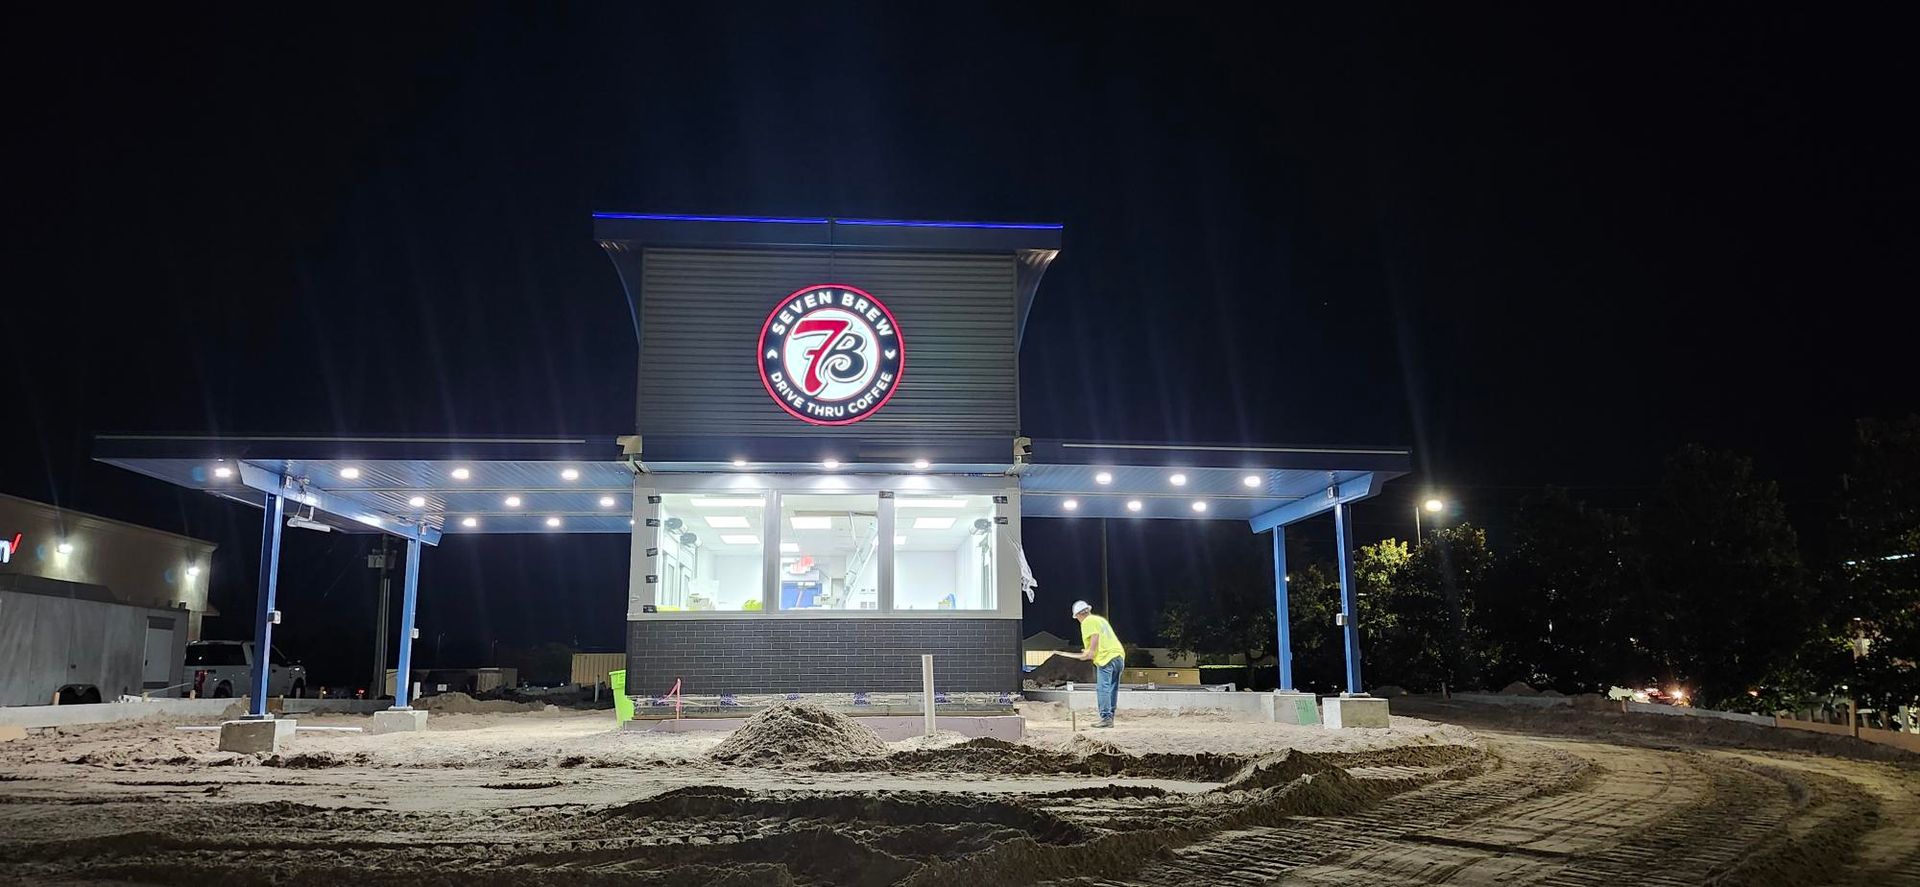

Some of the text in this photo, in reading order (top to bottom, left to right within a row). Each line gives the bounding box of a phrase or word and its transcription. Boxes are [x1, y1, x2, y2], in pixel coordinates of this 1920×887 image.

[772, 291, 893, 337] SEVEN BREW
[770, 371, 893, 417] DRIVE THRU COFFEE
